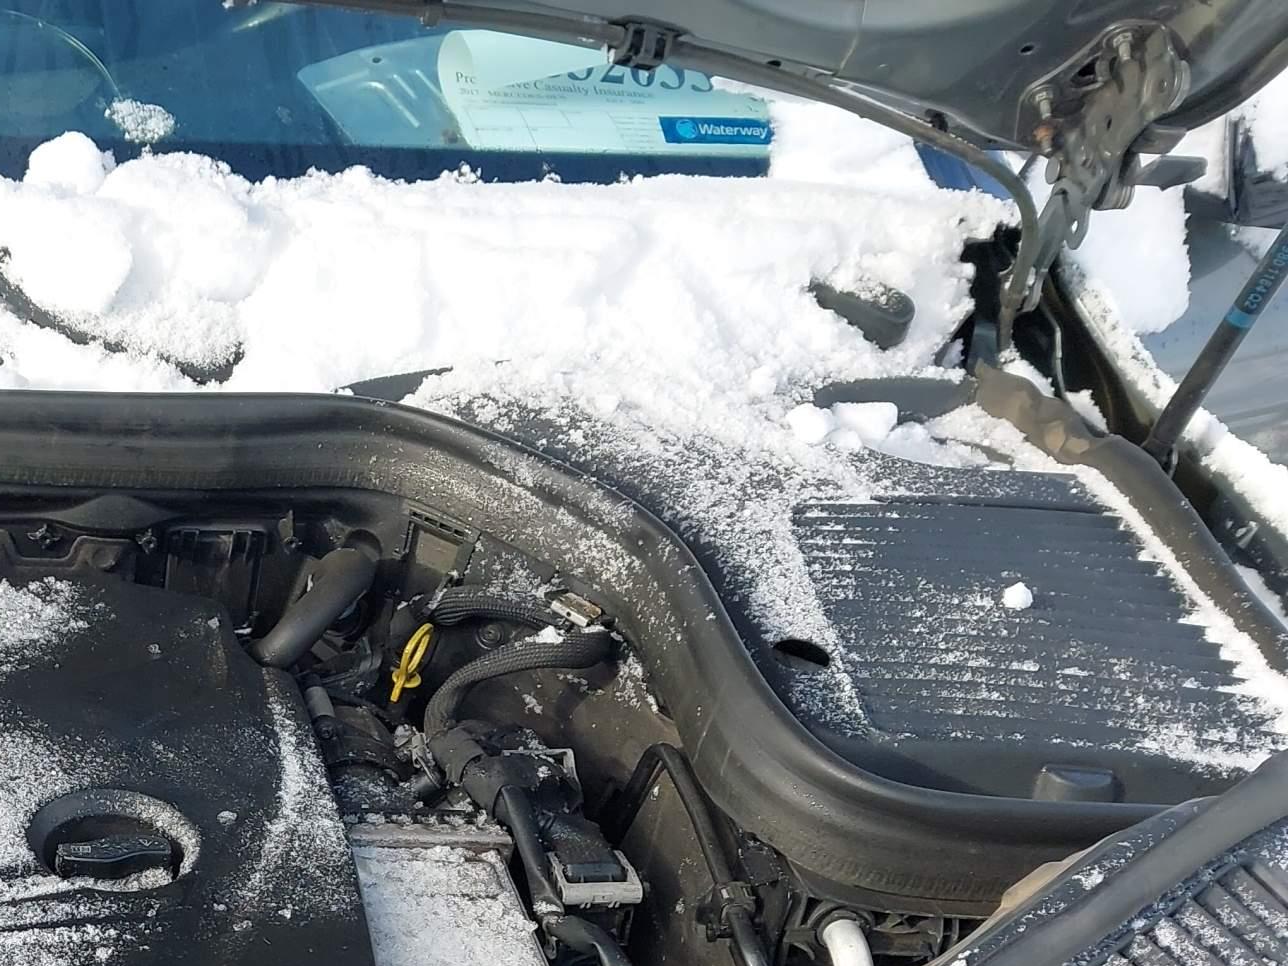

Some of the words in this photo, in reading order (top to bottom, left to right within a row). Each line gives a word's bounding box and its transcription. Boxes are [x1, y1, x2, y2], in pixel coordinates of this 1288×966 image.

[534, 79, 588, 95] Casualty
[594, 85, 654, 98] Insurance
[698, 123, 768, 139] Waterway
